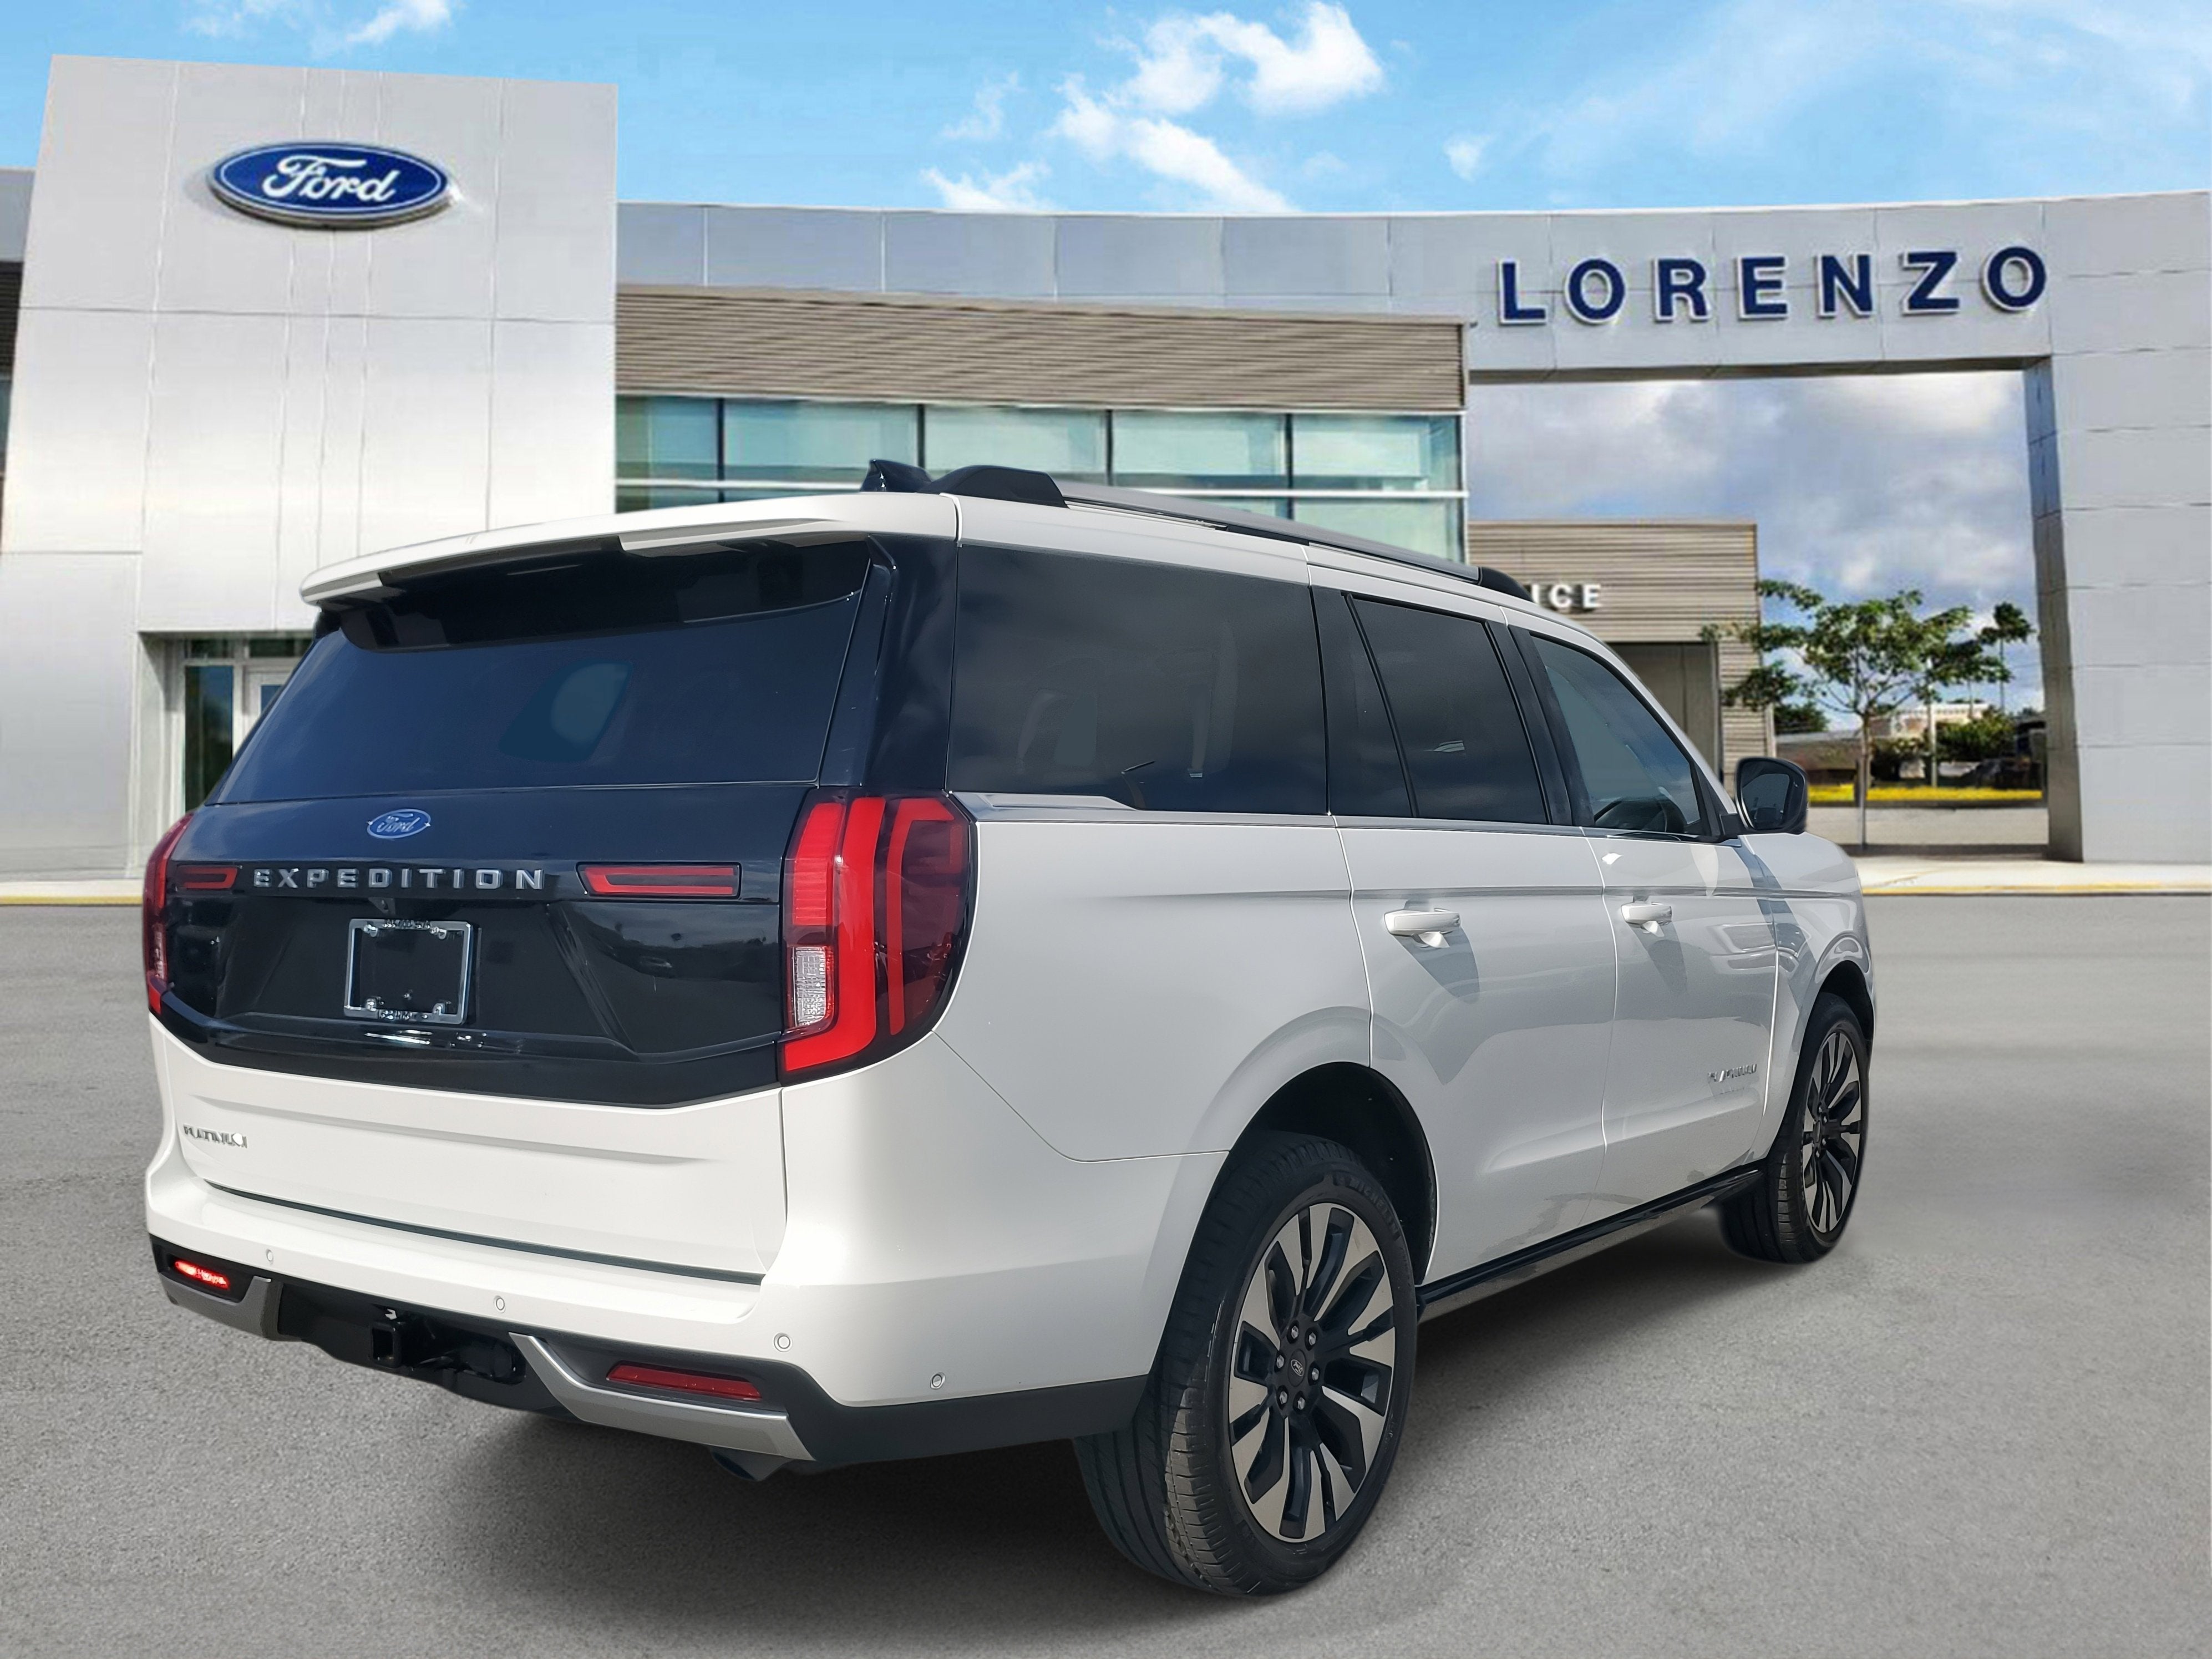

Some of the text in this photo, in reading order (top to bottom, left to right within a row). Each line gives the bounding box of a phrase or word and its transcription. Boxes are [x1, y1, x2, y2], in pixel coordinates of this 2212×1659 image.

[262, 155, 400, 202] Ford
[1498, 245, 2047, 324] LORENZO
[376, 811, 420, 833] Ford
[253, 868, 545, 890] EXPEDITION
